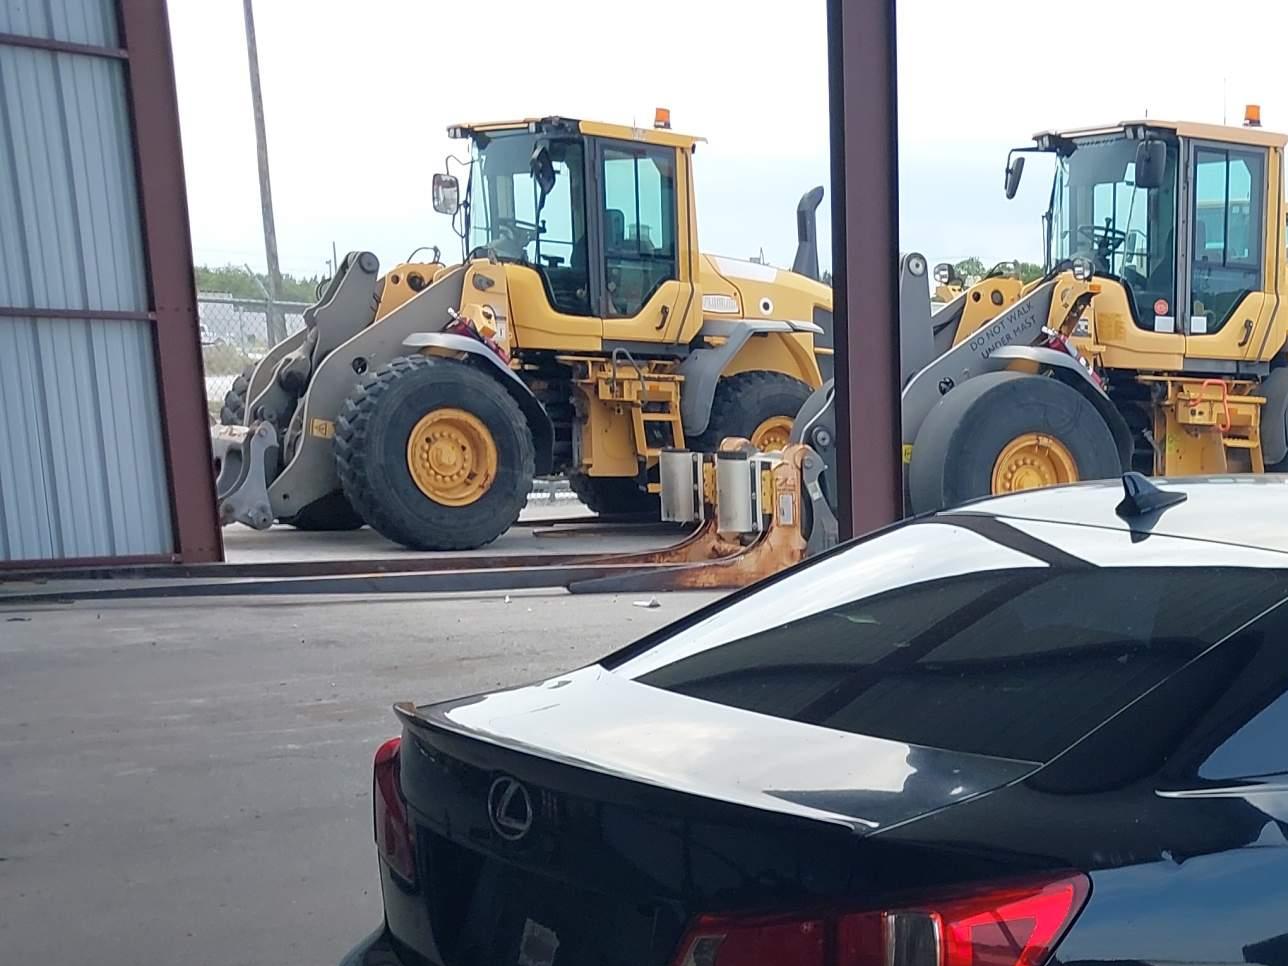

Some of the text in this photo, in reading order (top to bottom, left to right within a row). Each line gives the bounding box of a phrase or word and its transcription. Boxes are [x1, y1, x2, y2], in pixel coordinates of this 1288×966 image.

[970, 300, 1032, 351] DO NOT WALK
[981, 314, 1037, 359] UNDER MAST
